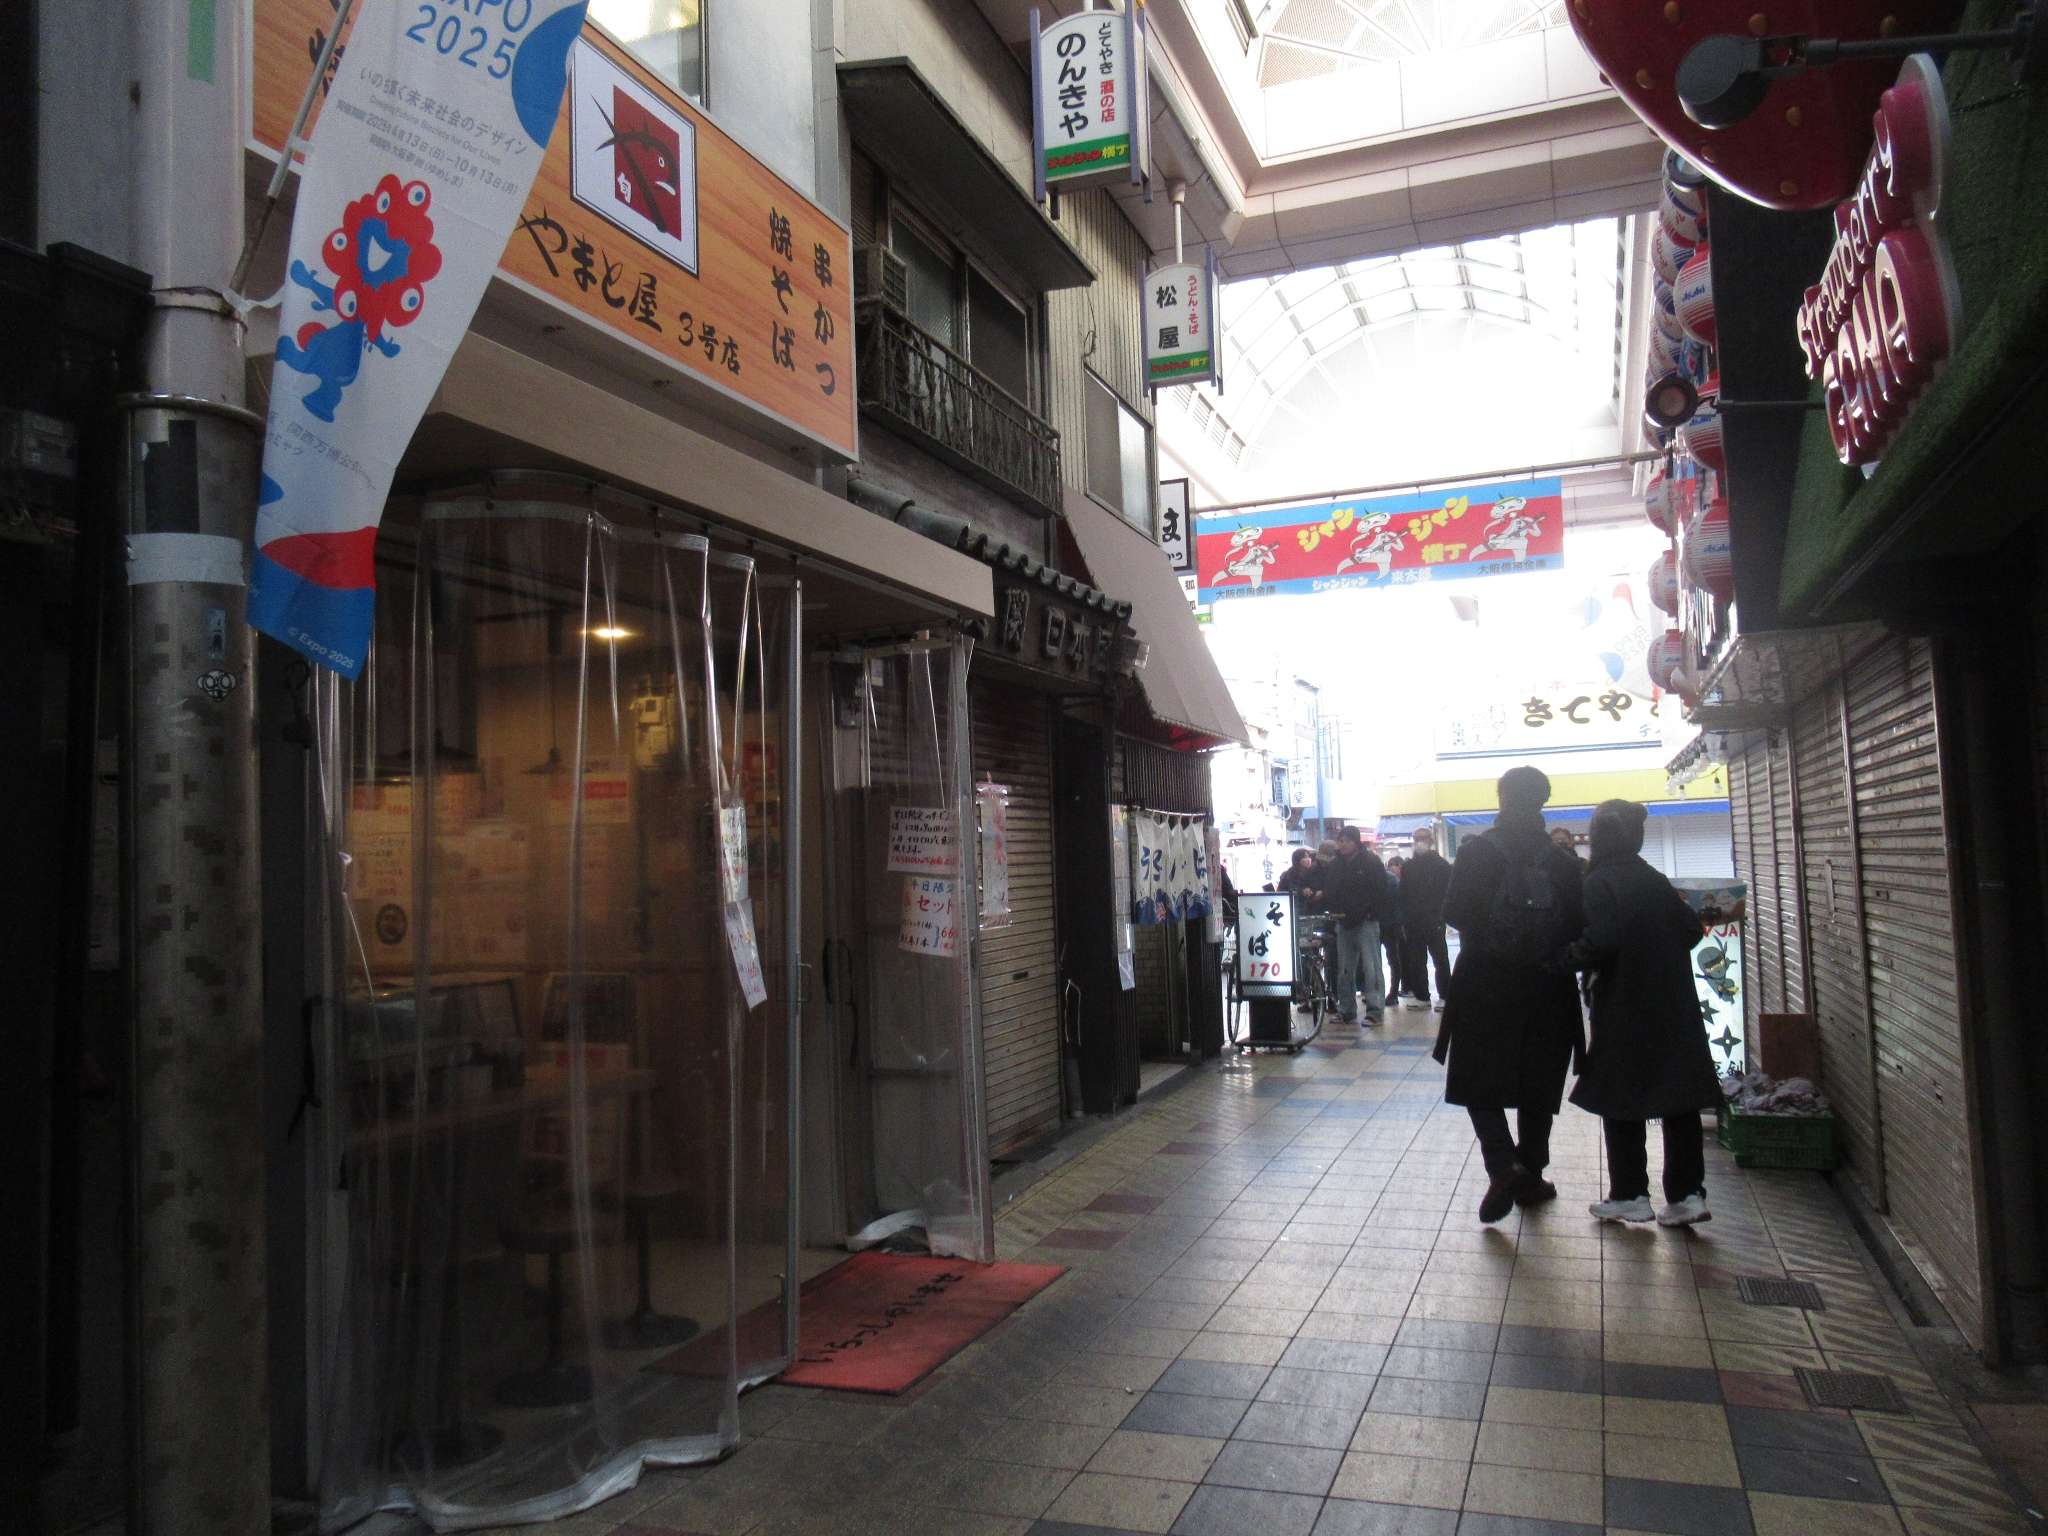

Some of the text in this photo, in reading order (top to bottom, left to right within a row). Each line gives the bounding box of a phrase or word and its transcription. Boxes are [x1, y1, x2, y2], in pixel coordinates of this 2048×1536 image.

[406, 5, 516, 79] 2025
[1056, 33, 1089, 138] のんきや
[1098, 22, 1115, 123] どてやき 酒の店
[513, 205, 741, 376] やまと屋 3号店
[769, 206, 795, 372] 焼そば
[1796, 108, 1895, 380] Strawberry
[813, 242, 836, 396] 串かつ
[1156, 284, 1180, 350] 松屋
[1296, 496, 1469, 553] ジャン ジャン
[299, 634, 328, 655] Expo
[328, 649, 355, 669] 2025
[1250, 962, 1281, 978] 170
